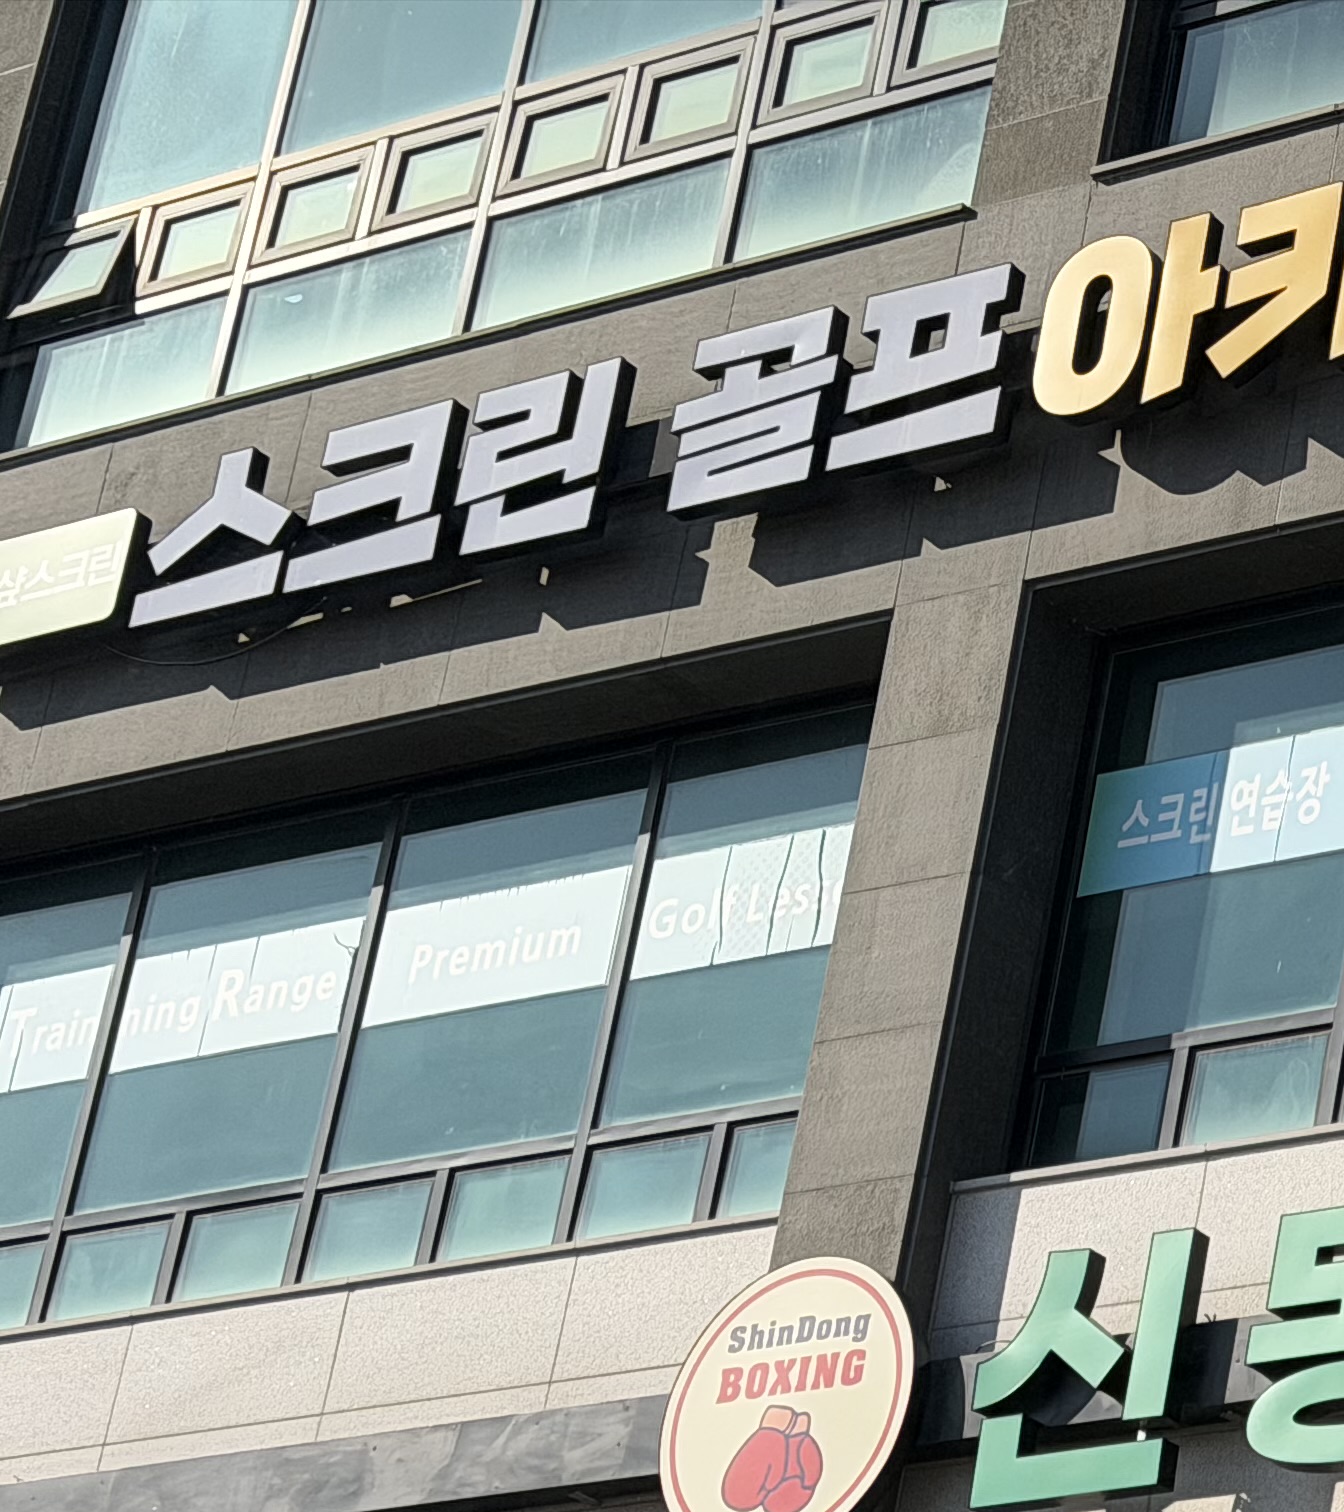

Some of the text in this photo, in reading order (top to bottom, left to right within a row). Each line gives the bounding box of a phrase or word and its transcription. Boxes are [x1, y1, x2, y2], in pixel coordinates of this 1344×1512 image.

[127, 356, 626, 628] 스크린
[667, 262, 1013, 512] 골프
[1116, 761, 1332, 849] 스크린 연습장
[408, 922, 582, 984] Premium
[210, 968, 337, 1022] Range
[727, 1312, 872, 1354] ShinDong
[715, 1349, 867, 1405] BOXING
